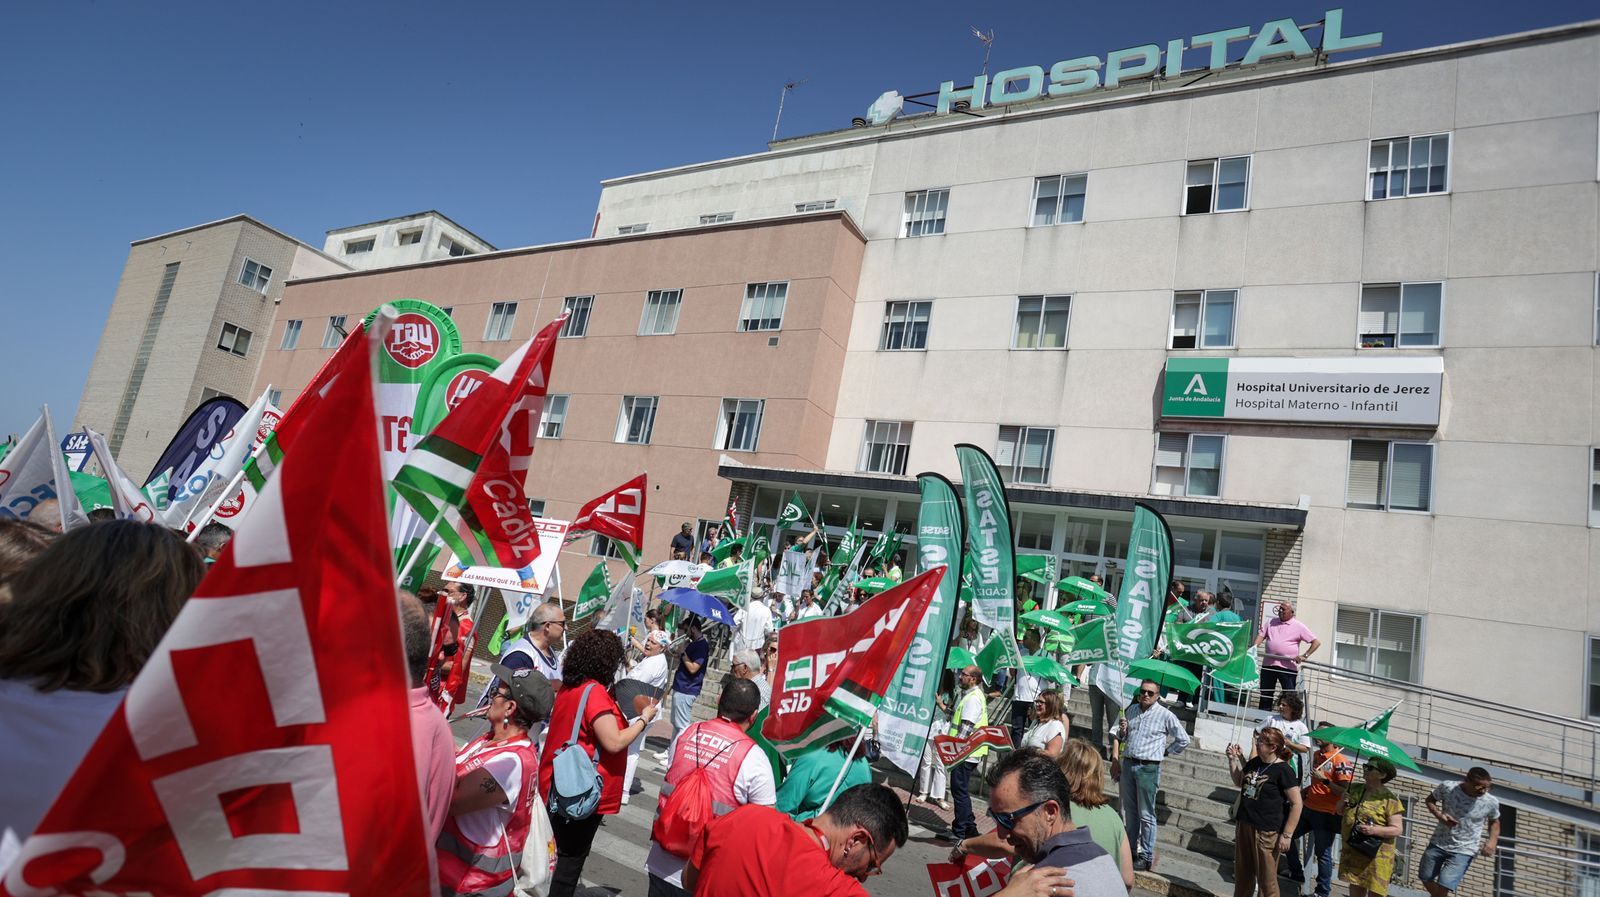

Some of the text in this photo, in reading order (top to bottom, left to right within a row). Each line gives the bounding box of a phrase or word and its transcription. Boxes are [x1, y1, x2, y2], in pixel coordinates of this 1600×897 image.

[937, 8, 1383, 115] HOSPITAL
[1235, 398, 1285, 411] Hospital
[1288, 400, 1340, 410] Materno
[1351, 401, 1398, 411] Infantil
[1237, 382, 1430, 395] Hospital Universitario de Jerez
[482, 479, 531, 558] Cádiz
